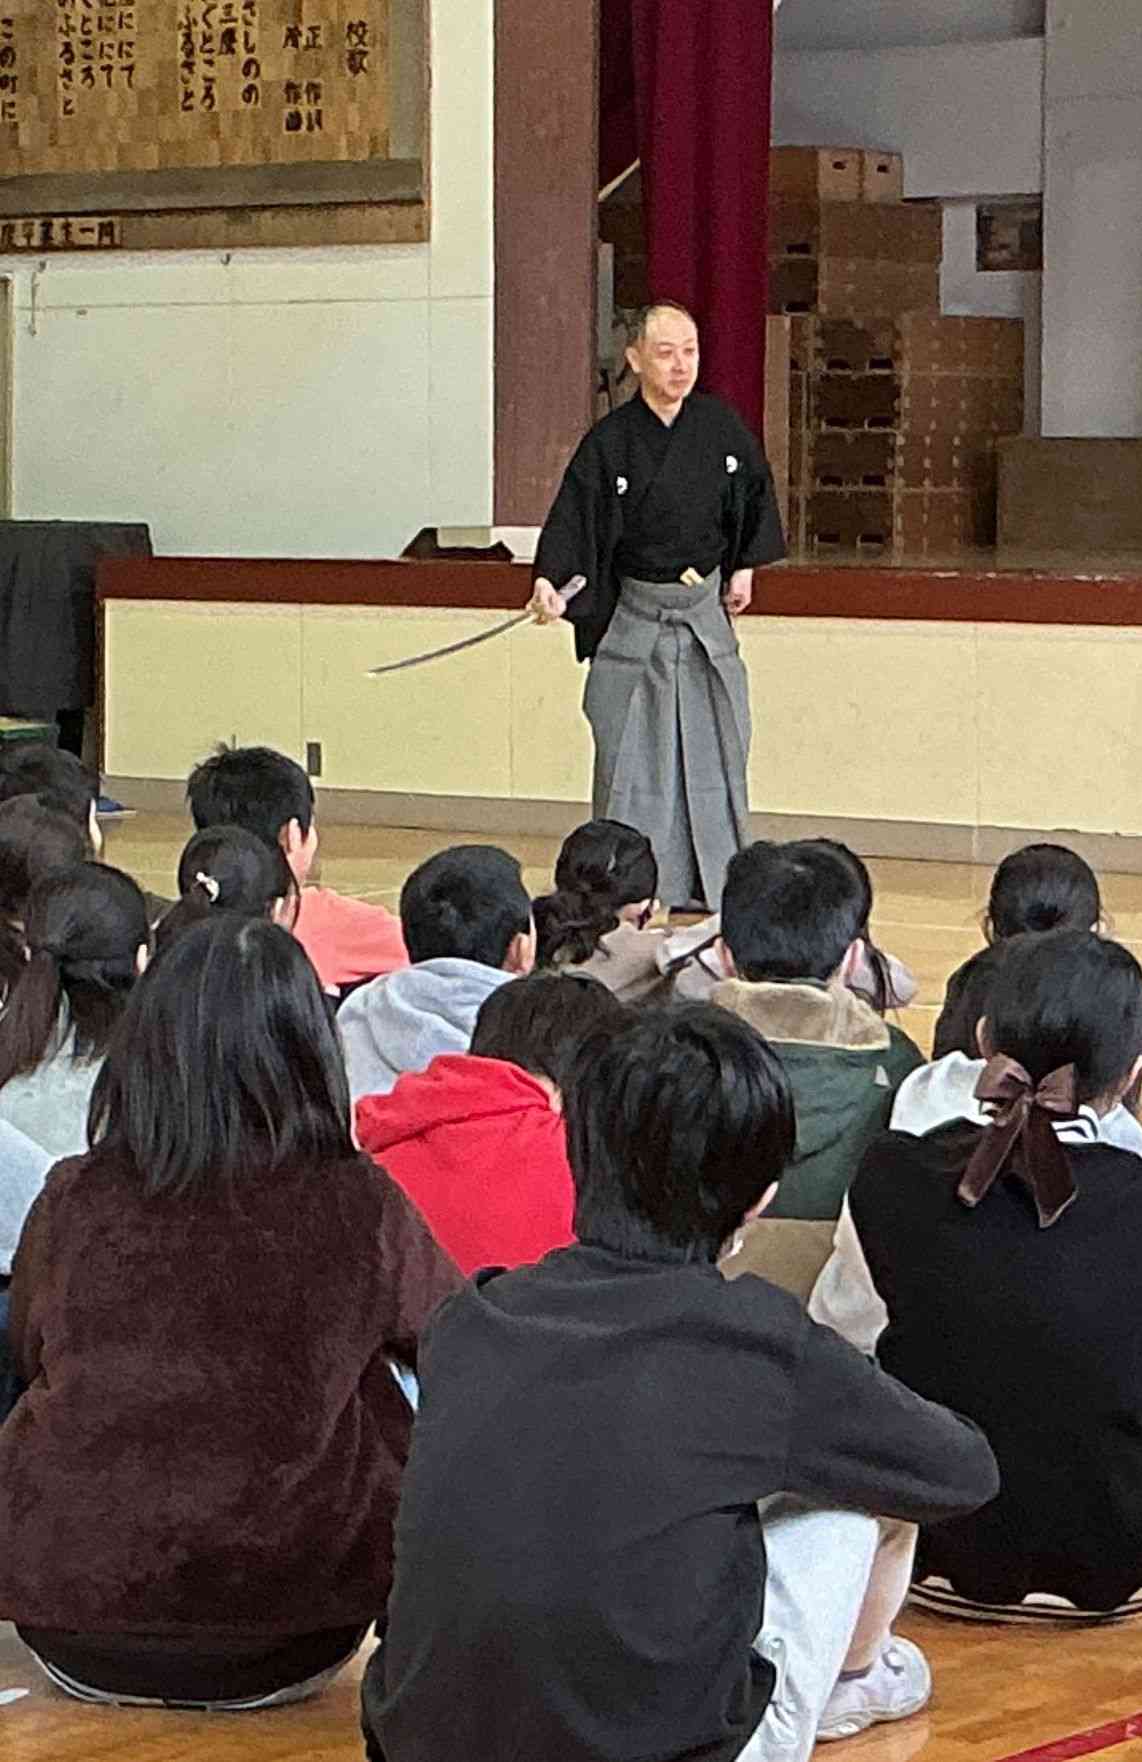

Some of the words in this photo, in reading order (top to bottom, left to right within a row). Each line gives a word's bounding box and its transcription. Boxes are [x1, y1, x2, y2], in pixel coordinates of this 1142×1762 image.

[97, 0, 117, 89] ににて
[117, 0, 136, 89] ににて
[303, 24, 323, 51] 正
[345, 20, 369, 76] 校歌
